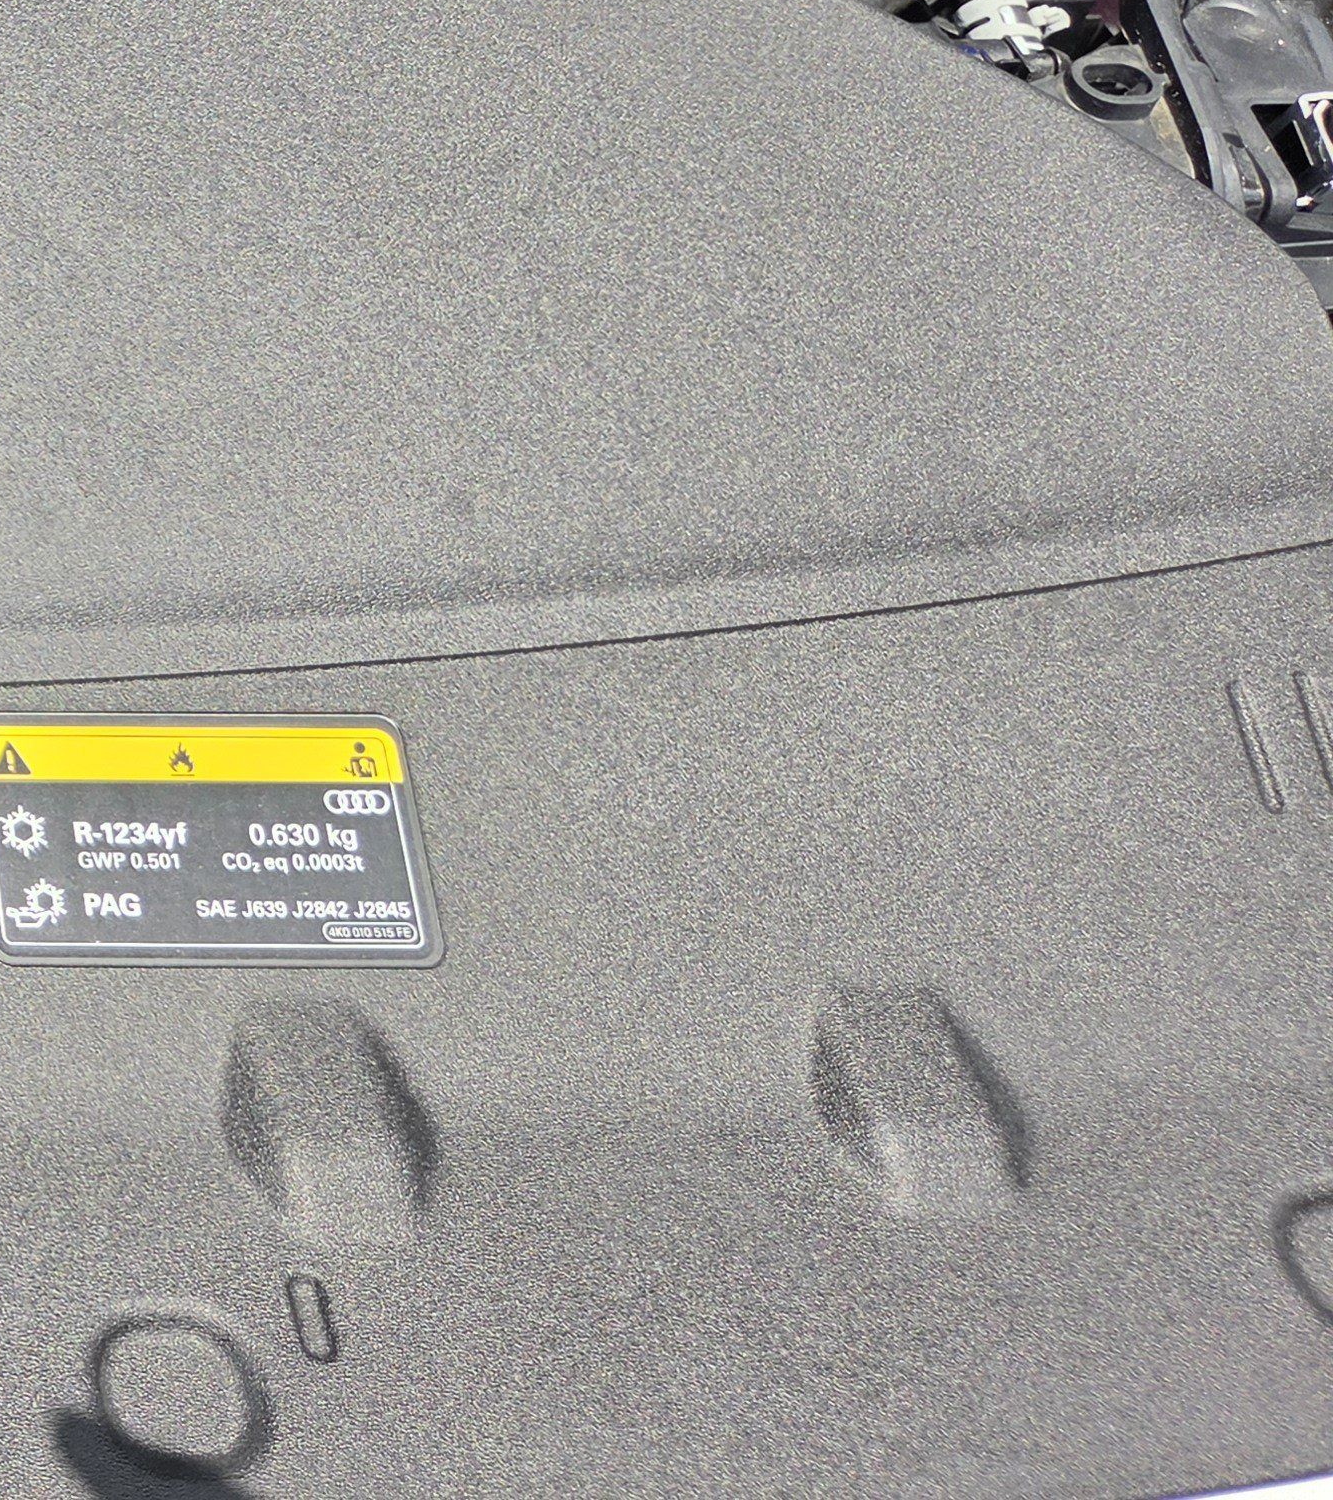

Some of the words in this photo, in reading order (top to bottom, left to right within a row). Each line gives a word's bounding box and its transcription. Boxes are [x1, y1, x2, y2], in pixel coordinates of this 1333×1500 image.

[73, 821, 187, 849] R-1234yf
[249, 823, 319, 846] 0.630
[327, 823, 358, 850] kg
[78, 852, 126, 870] GWP
[130, 852, 180, 870] 0.501
[264, 855, 289, 874] eq
[292, 854, 365, 872] 0.0003t
[83, 893, 142, 917] PAG
[196, 900, 237, 918] SAE
[242, 901, 287, 918] J639
[292, 902, 350, 919] J2842
[354, 902, 411, 919] J2845
[352, 928, 372, 938] 010
[374, 928, 394, 938] 515
[396, 928, 411, 939] FE
